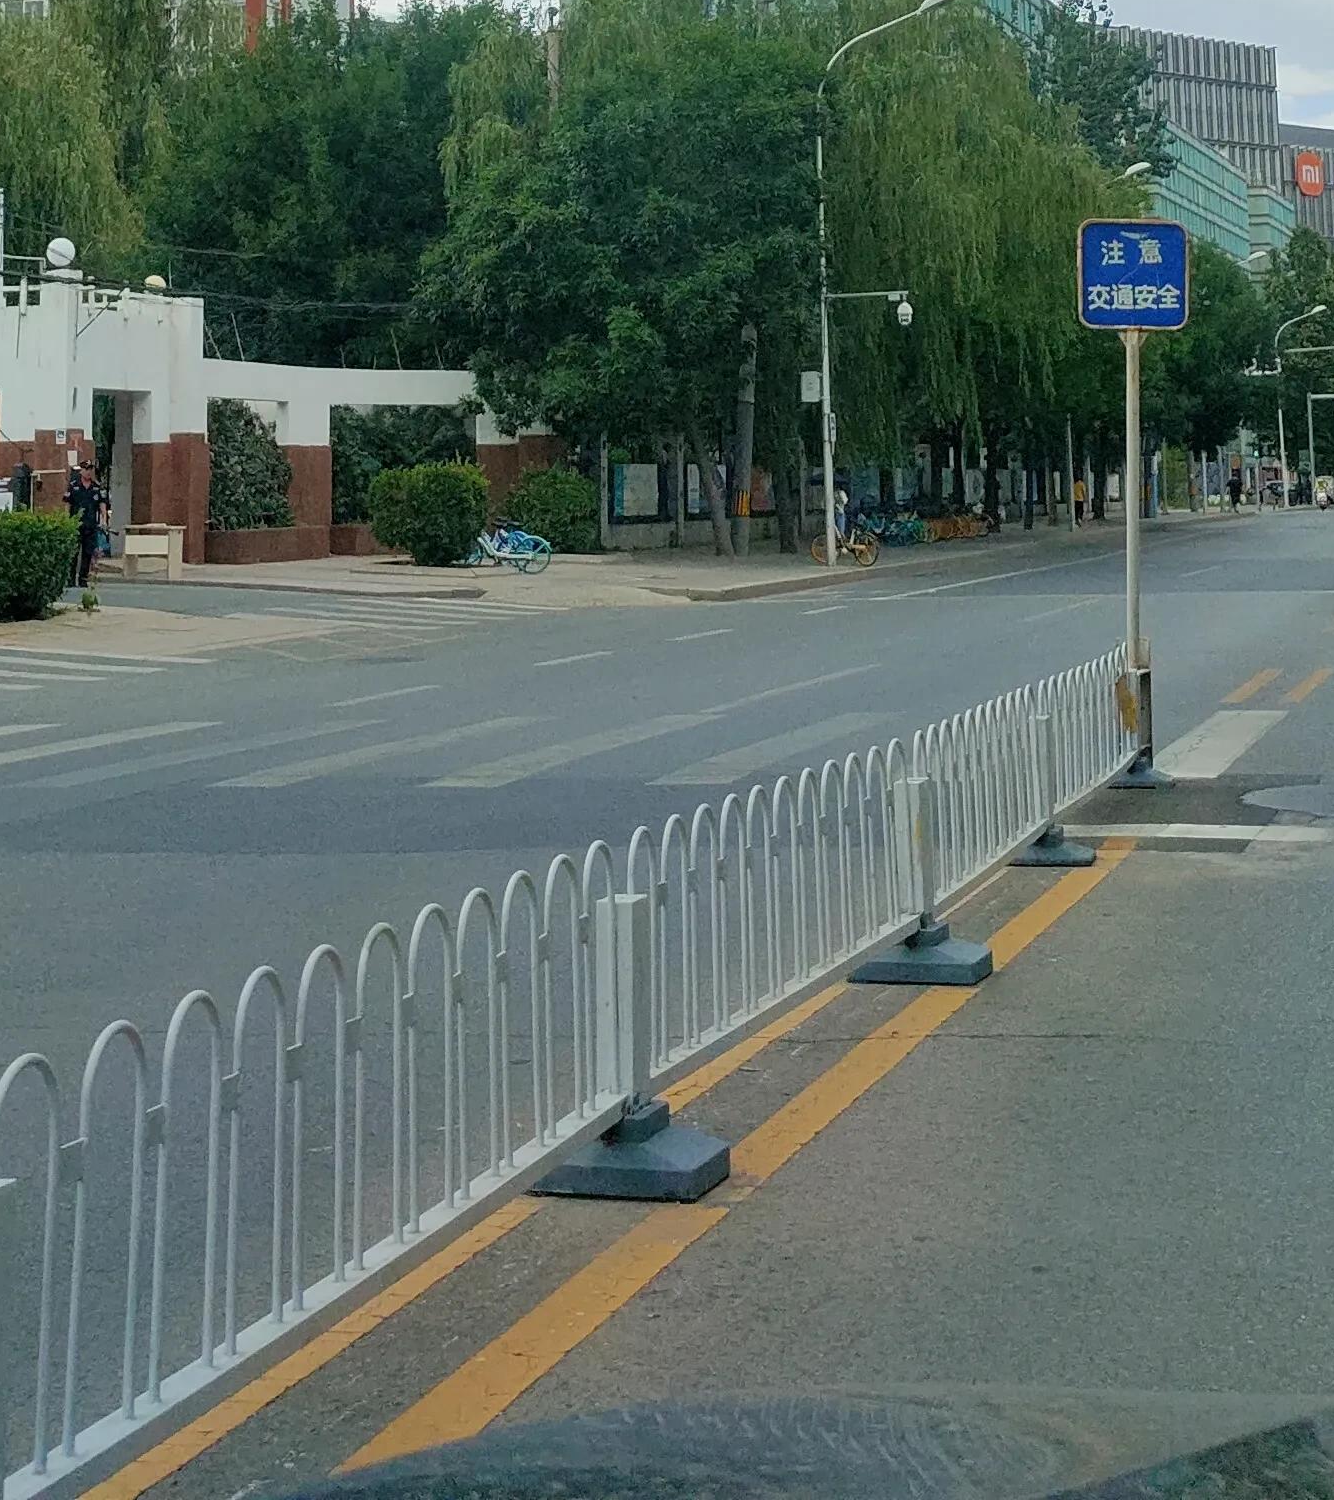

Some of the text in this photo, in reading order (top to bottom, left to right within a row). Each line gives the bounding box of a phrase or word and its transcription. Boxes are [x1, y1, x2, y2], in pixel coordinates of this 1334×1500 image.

[1100, 238, 1163, 266] 注意
[1087, 283, 1181, 310] 交通安全
